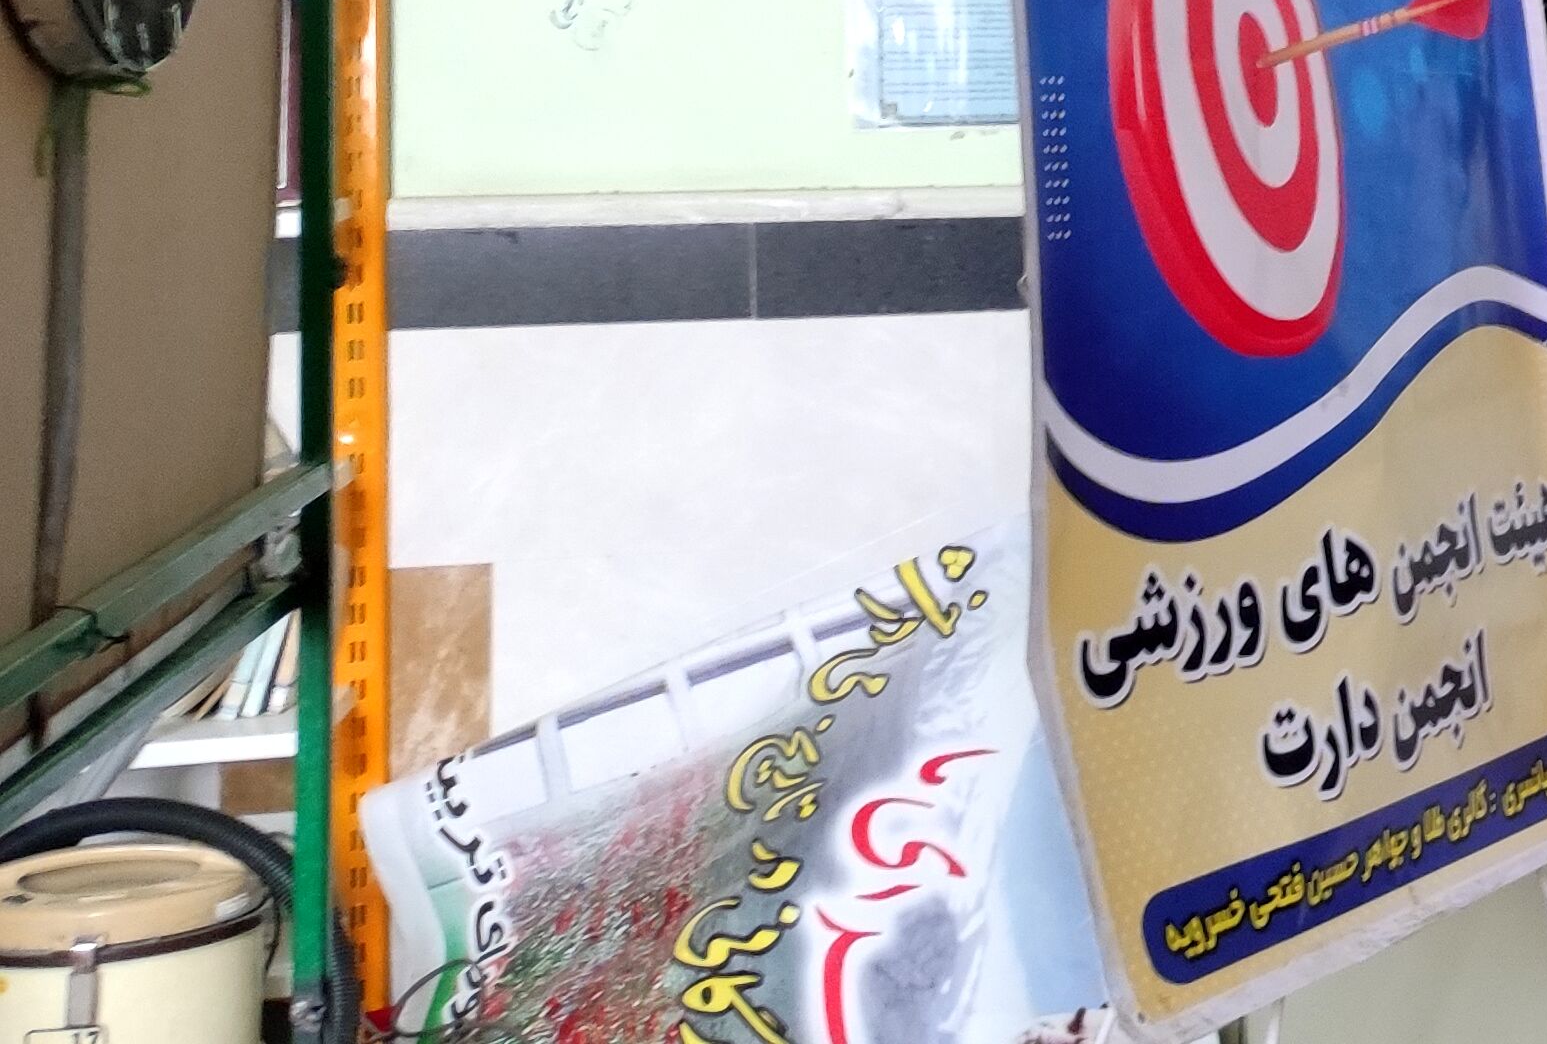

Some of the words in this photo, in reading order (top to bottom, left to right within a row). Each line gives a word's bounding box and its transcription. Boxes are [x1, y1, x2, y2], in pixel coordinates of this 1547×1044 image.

[1280, 527, 1378, 646] های
[1392, 492, 1484, 617] انجمن
[1080, 568, 1263, 701] ورزشی
[1261, 676, 1380, 792] دارت
[1392, 629, 1491, 767] انجمن
[1248, 861, 1307, 930] فتحی
[1306, 850, 1361, 906] حسین
